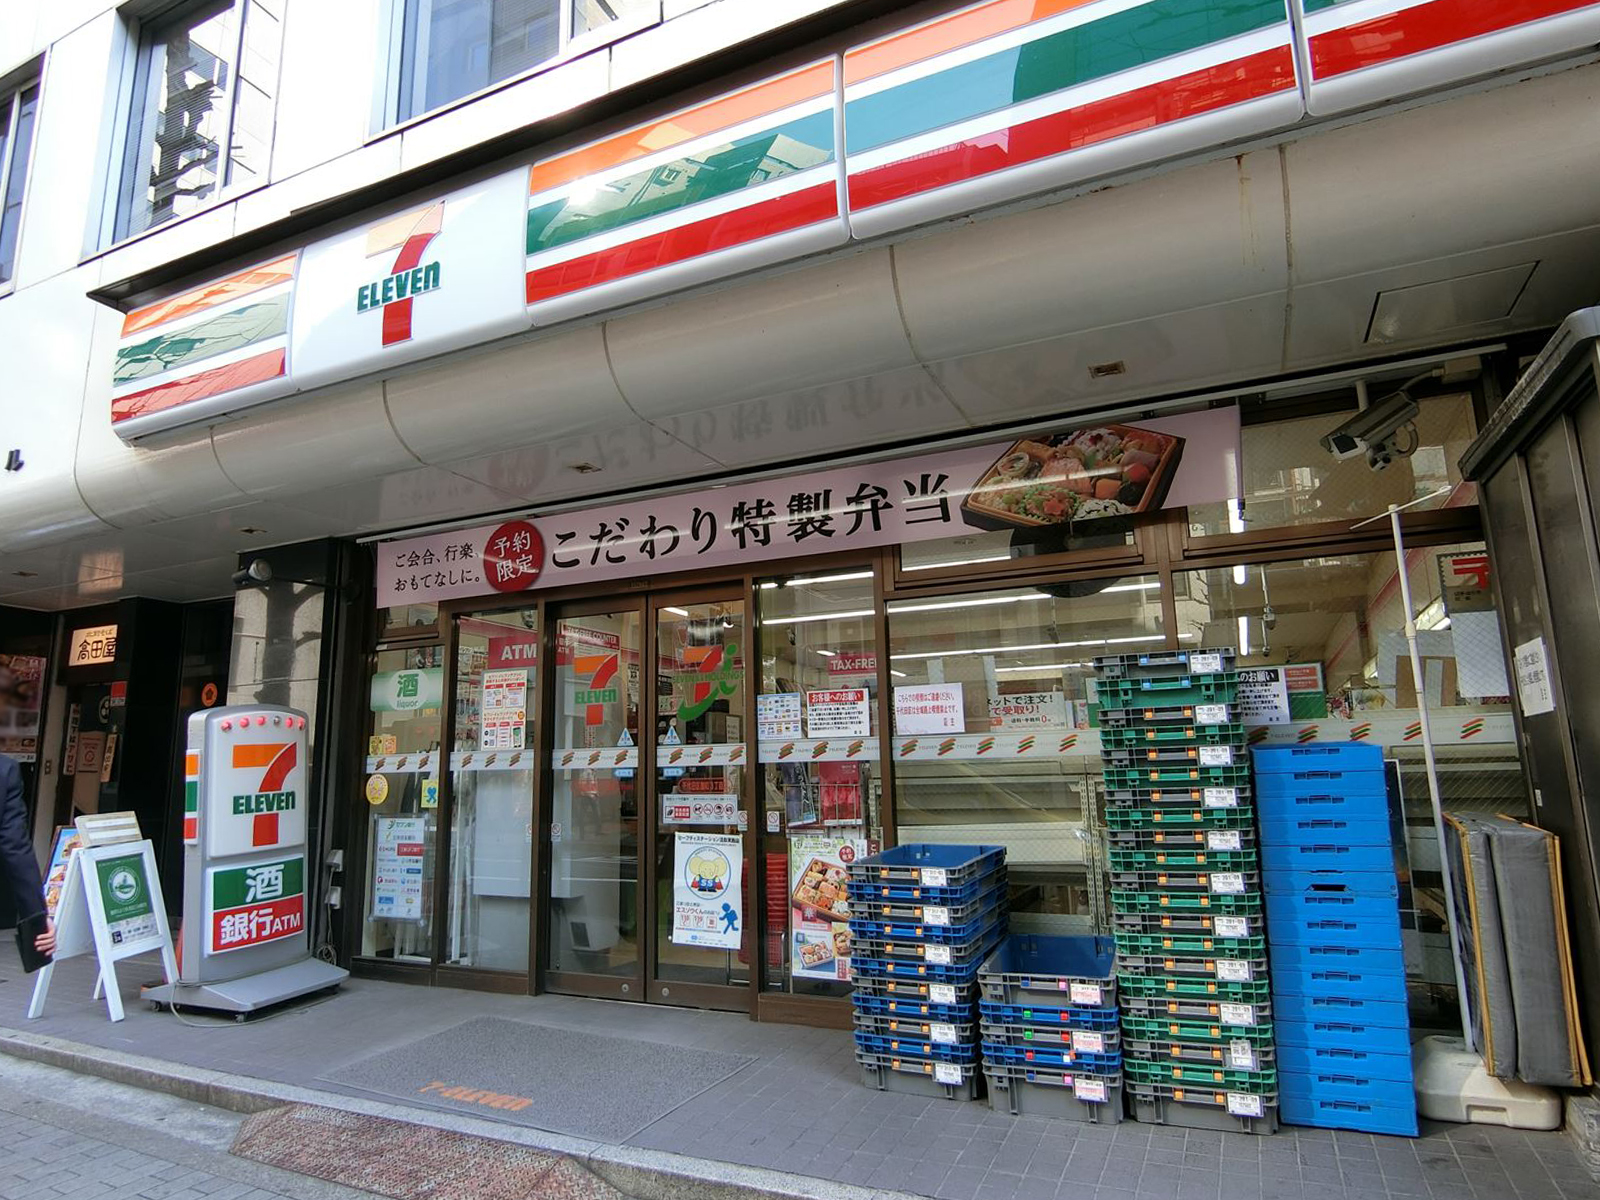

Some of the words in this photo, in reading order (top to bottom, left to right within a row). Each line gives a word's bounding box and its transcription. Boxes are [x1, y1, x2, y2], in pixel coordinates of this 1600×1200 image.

[552, 473, 951, 568] こだわり特製弁当
[493, 530, 531, 558] 予約
[496, 554, 535, 582] 限定
[394, 569, 480, 592] おもてなしに。
[77, 637, 116, 661] 高田屋
[501, 642, 537, 661] ATM
[830, 658, 877, 671] TAX-FRE
[1238, 671, 1275, 682] のお願い
[396, 673, 419, 697] 酒
[245, 865, 284, 903] 酒
[220, 907, 302, 945] 銀行ATM
